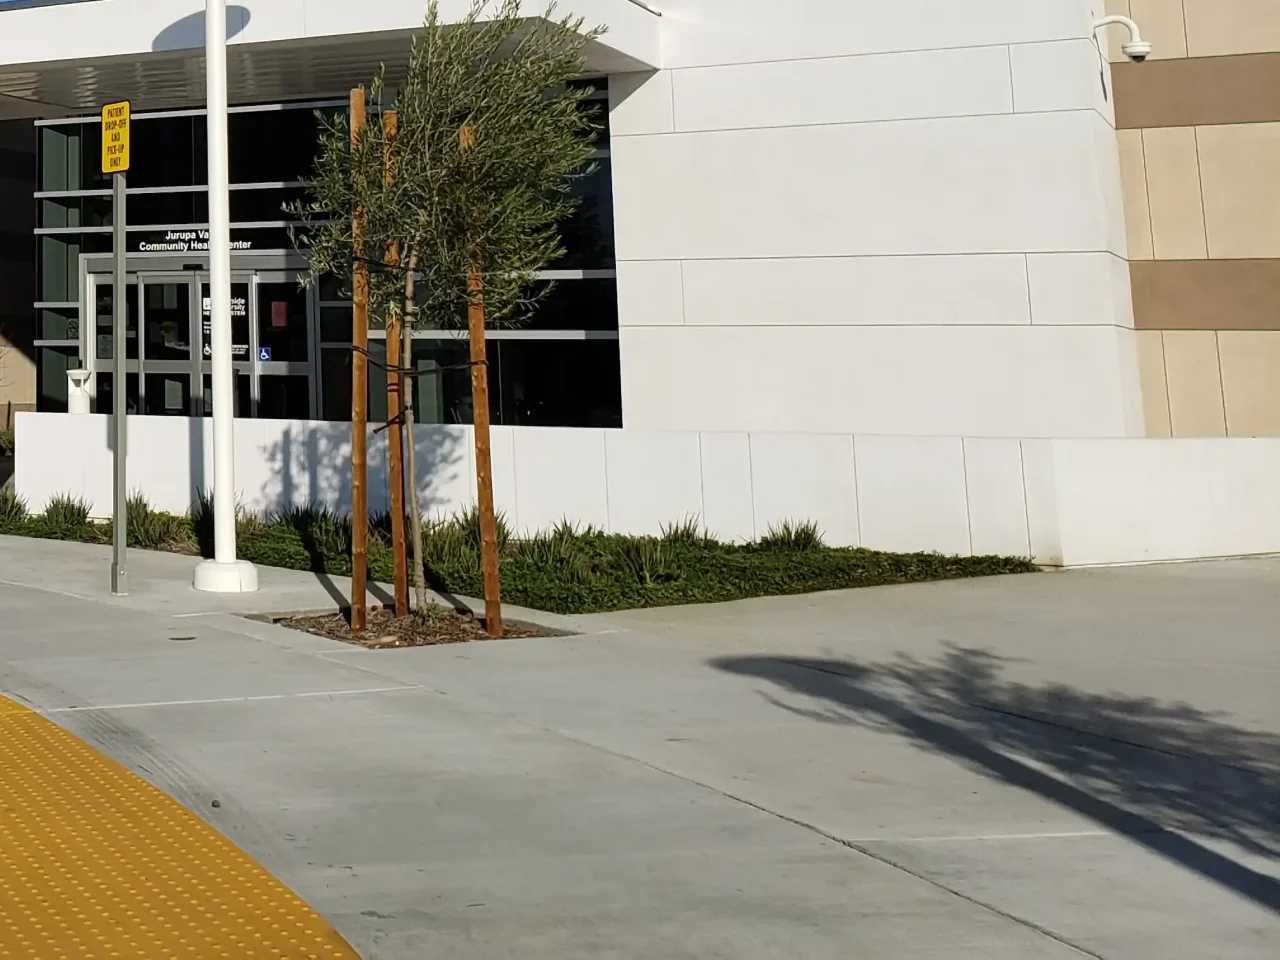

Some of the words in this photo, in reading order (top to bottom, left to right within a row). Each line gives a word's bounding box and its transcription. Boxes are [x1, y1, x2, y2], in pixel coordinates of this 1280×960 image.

[107, 106, 124, 118] PATIENT
[105, 118, 127, 131] DROP-OFF
[111, 132, 120, 142] AND
[107, 143, 125, 156] PICK-UP
[110, 157, 121, 168] ONLY
[165, 230, 196, 241] Jurupa
[139, 241, 189, 252] Community
[190, 240, 210, 250] Heal
[229, 241, 252, 249] enter
